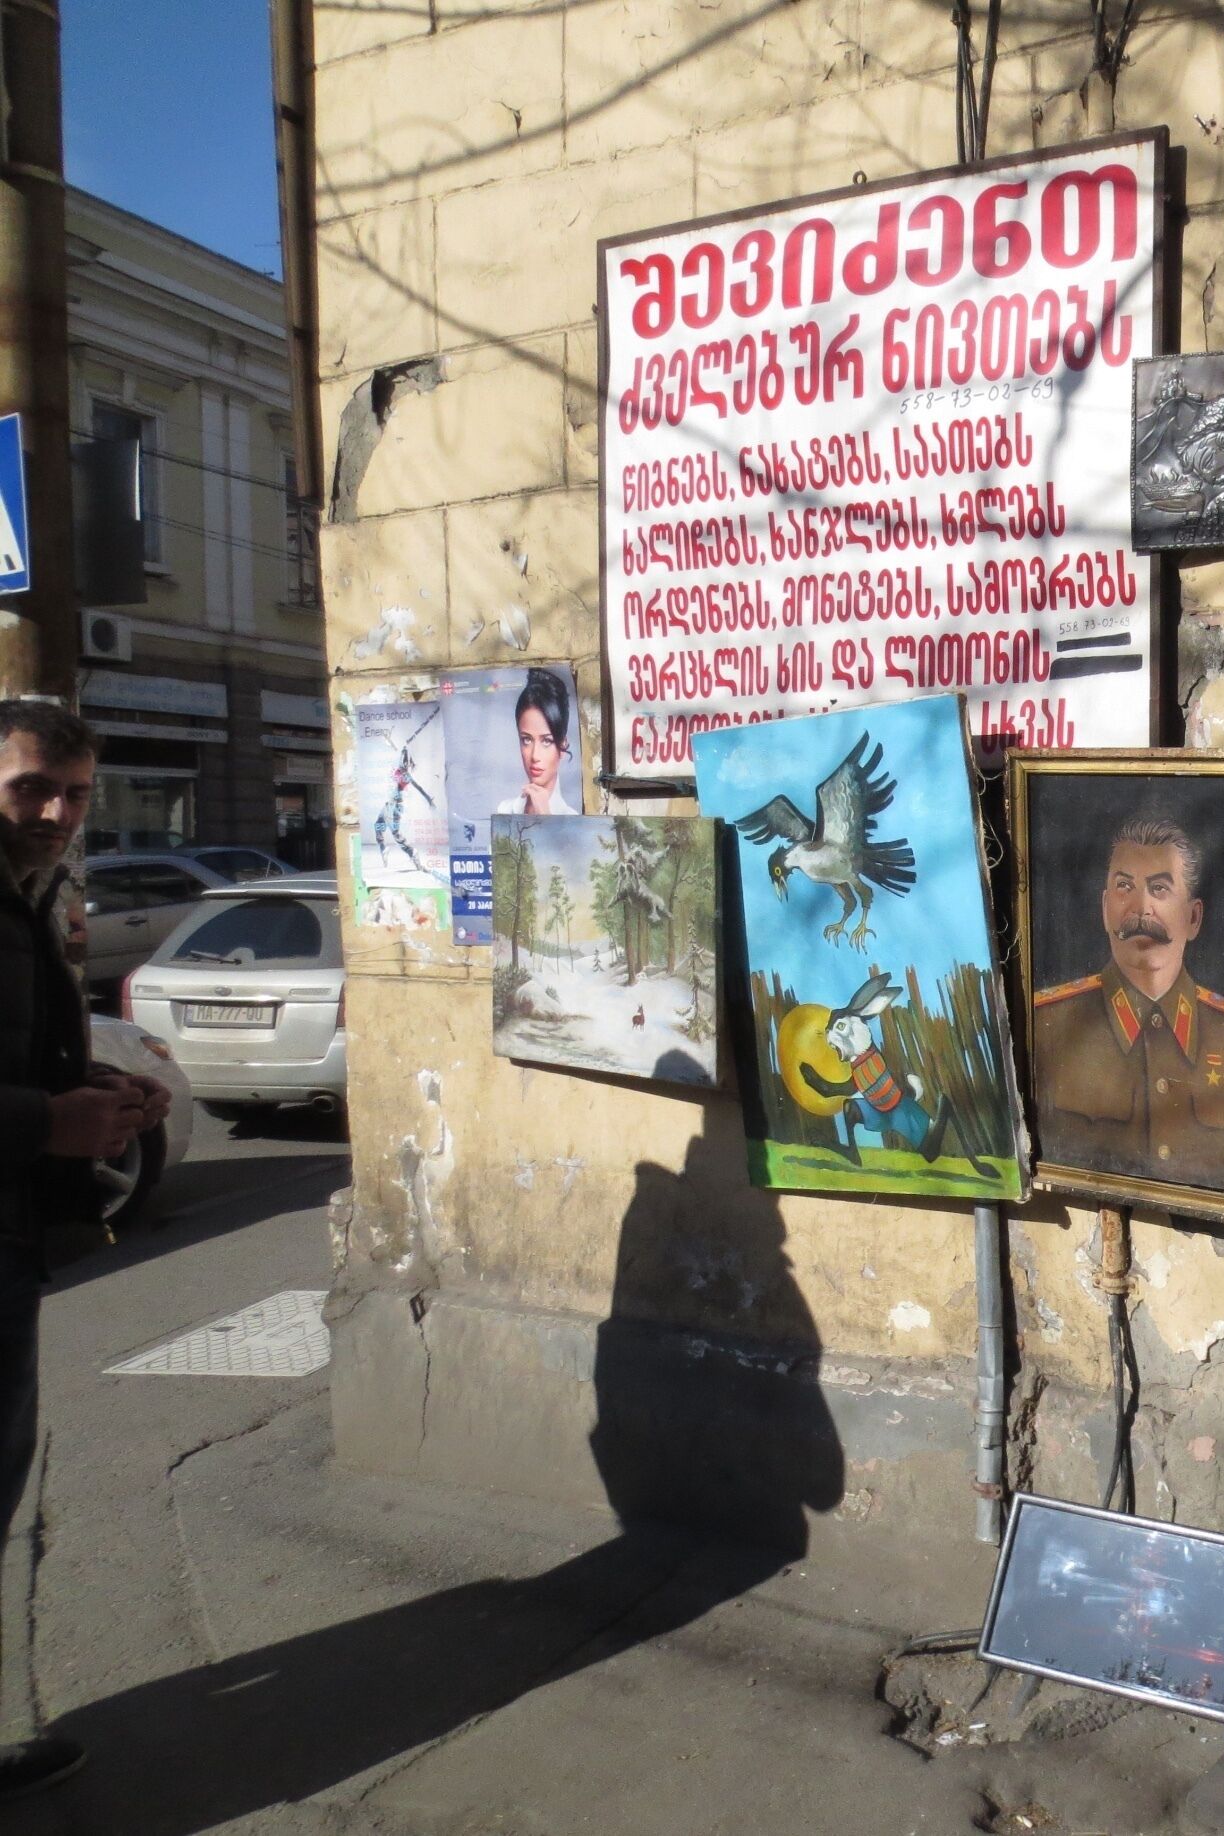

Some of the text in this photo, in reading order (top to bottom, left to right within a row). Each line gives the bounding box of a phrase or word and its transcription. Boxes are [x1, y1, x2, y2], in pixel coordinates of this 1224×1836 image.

[619, 163, 1139, 340] შევიძენთ
[619, 279, 1133, 435] ძველებურ ნივთებს
[623, 412, 1033, 512] წიგნებს, ნახატებს, საათებს
[623, 481, 1066, 576] ხალიჩებს, ხანჯლებს, ხმლებს
[624, 549, 1137, 639] ორდენებს, მონეტებს, სამოვრებს
[628, 629, 1052, 702] ვერცხლის ხის და ლითონის
[359, 709, 412, 721] Dance school
[981, 698, 1075, 754] სხვას
